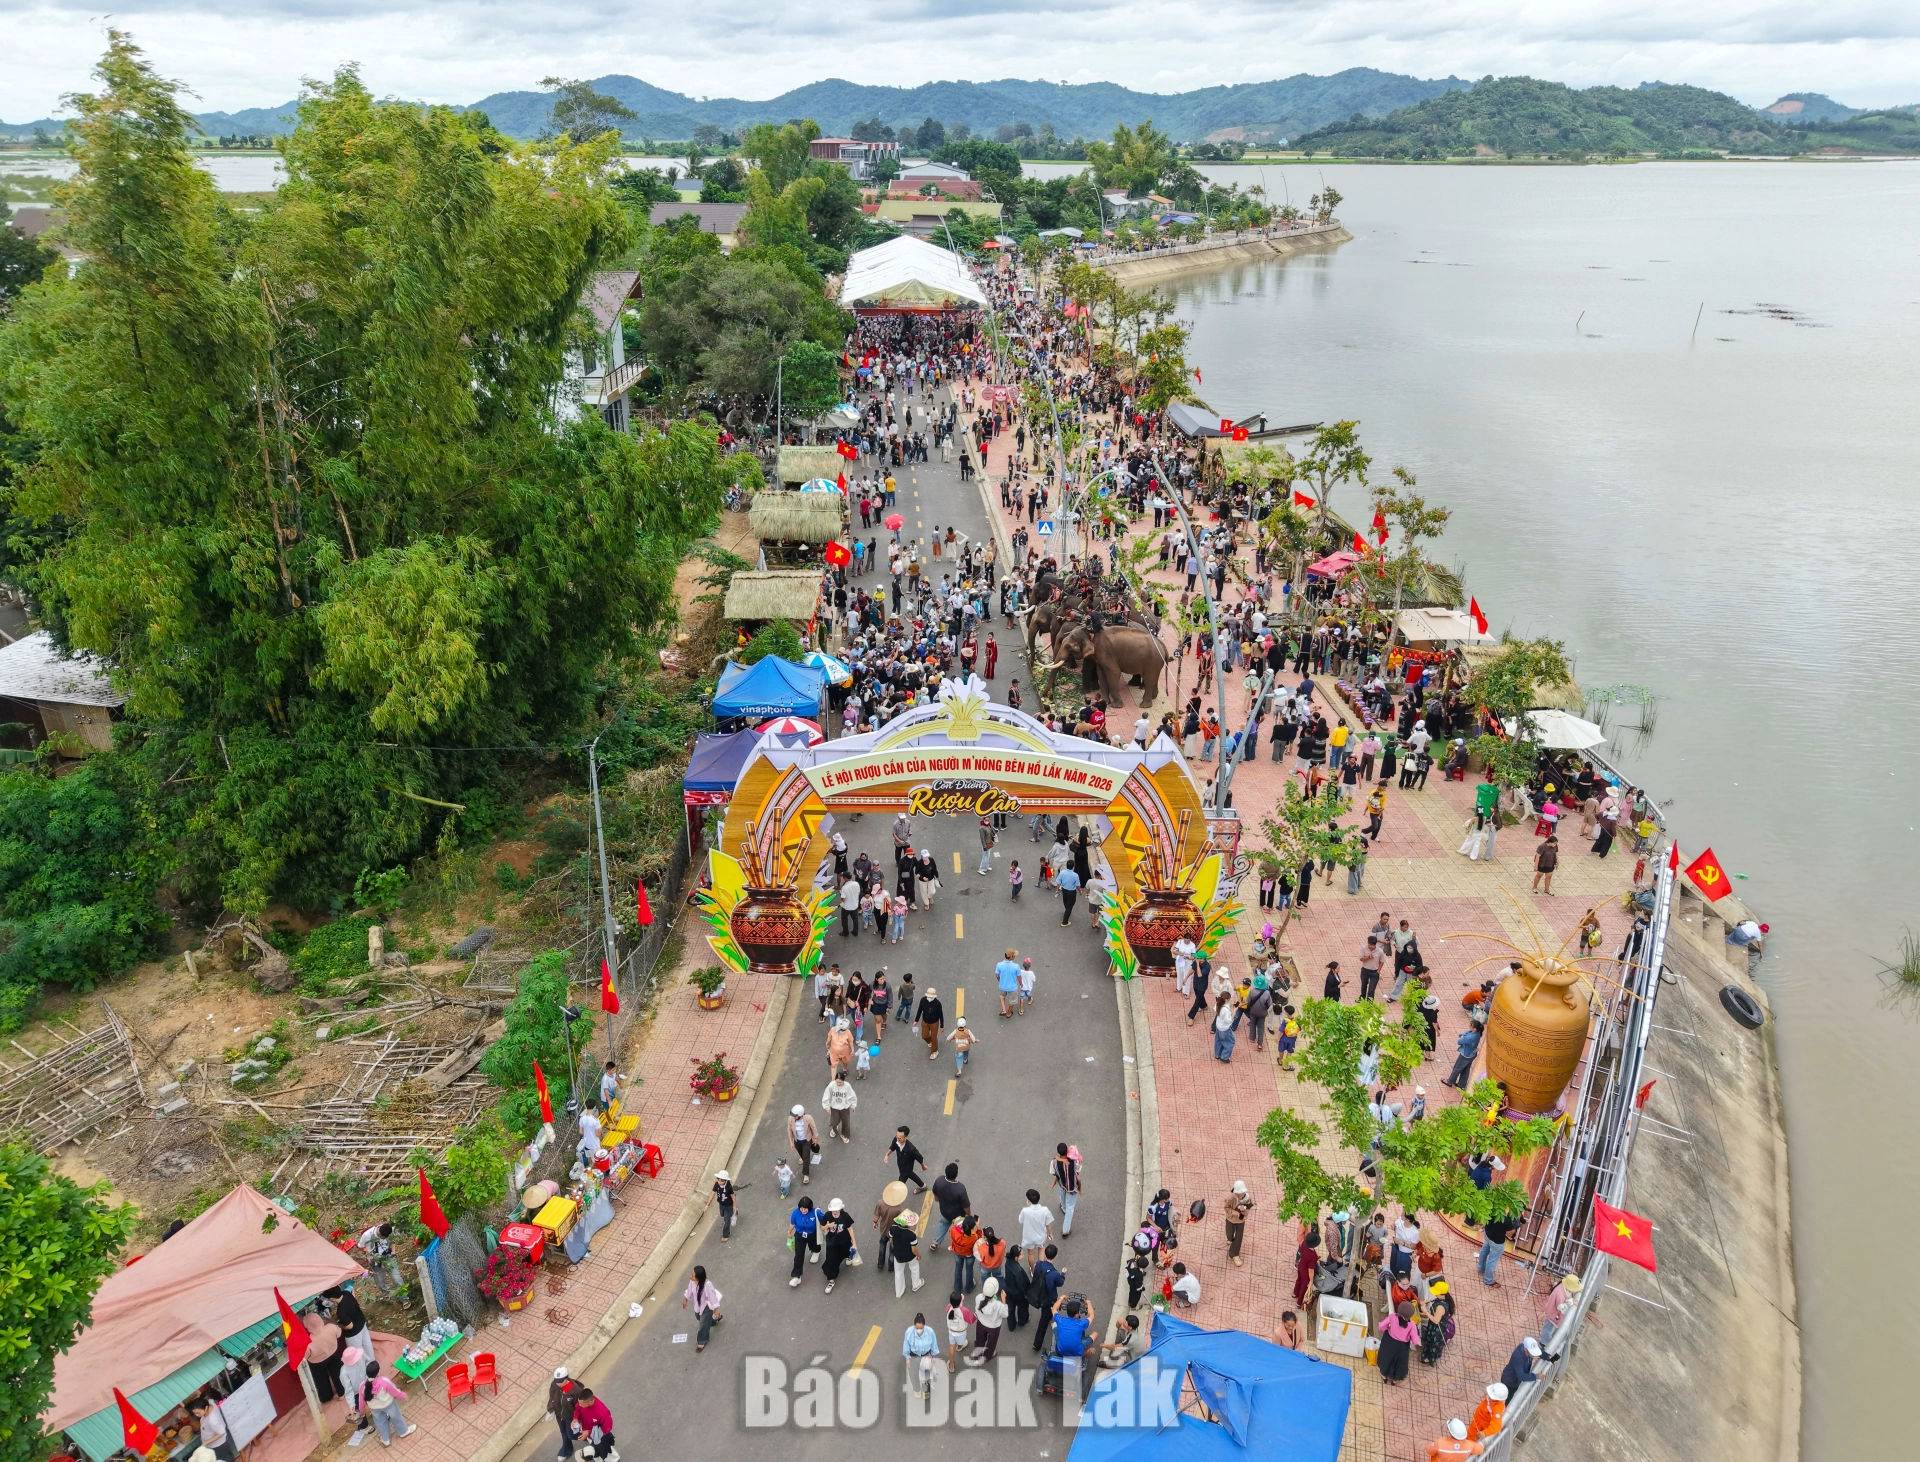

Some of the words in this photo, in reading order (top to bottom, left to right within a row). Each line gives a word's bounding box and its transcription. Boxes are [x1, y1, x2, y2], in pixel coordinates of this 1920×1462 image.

[740, 705, 792, 715] vinaphone
[835, 768, 853, 785] HỘI
[854, 764, 881, 781] RƯỢU
[906, 755, 927, 773] CỦA
[929, 755, 959, 771] NGƯỜI
[1063, 768, 1087, 785] NĂM
[1088, 774, 1113, 792] 2026
[933, 779, 953, 791] Con
[909, 787, 976, 816] Rượu
